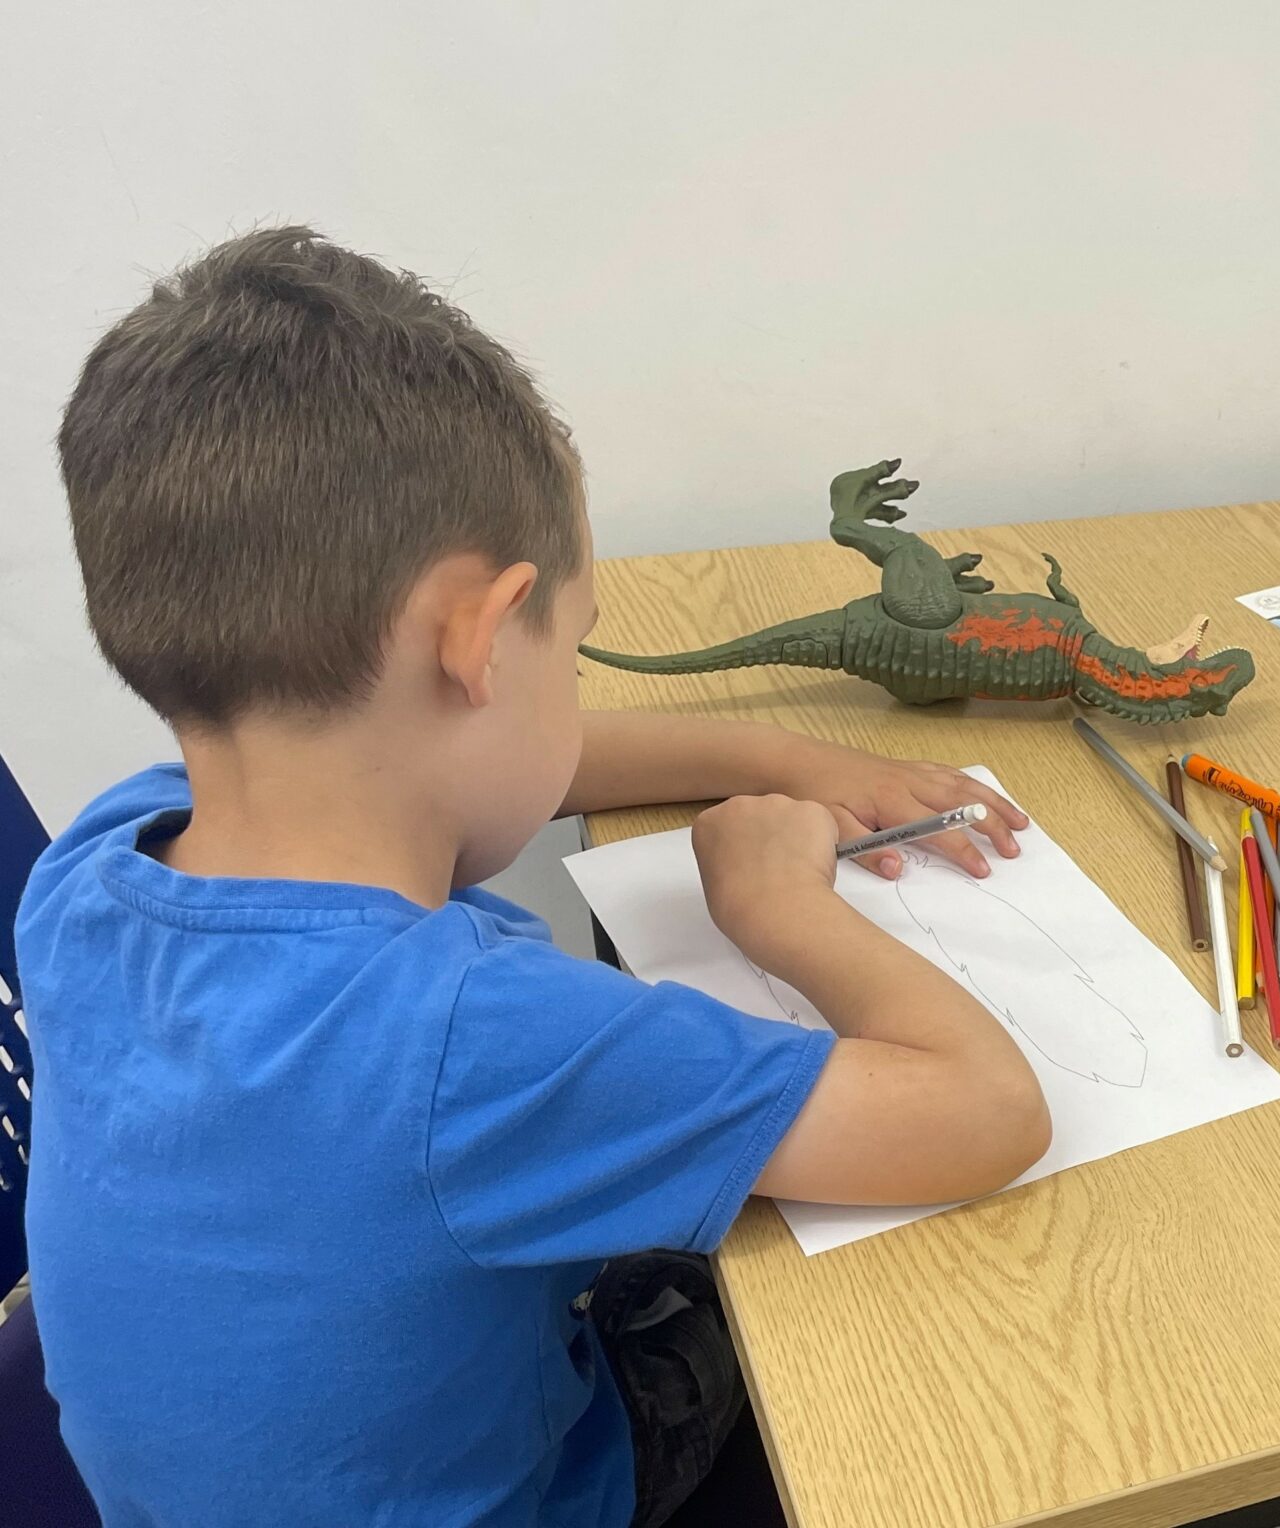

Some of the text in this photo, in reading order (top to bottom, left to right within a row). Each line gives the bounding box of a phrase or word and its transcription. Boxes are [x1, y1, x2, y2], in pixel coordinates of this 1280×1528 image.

[860, 839, 884, 850] Adoption
[885, 834, 898, 843] with
[898, 830, 917, 839] Sefton
